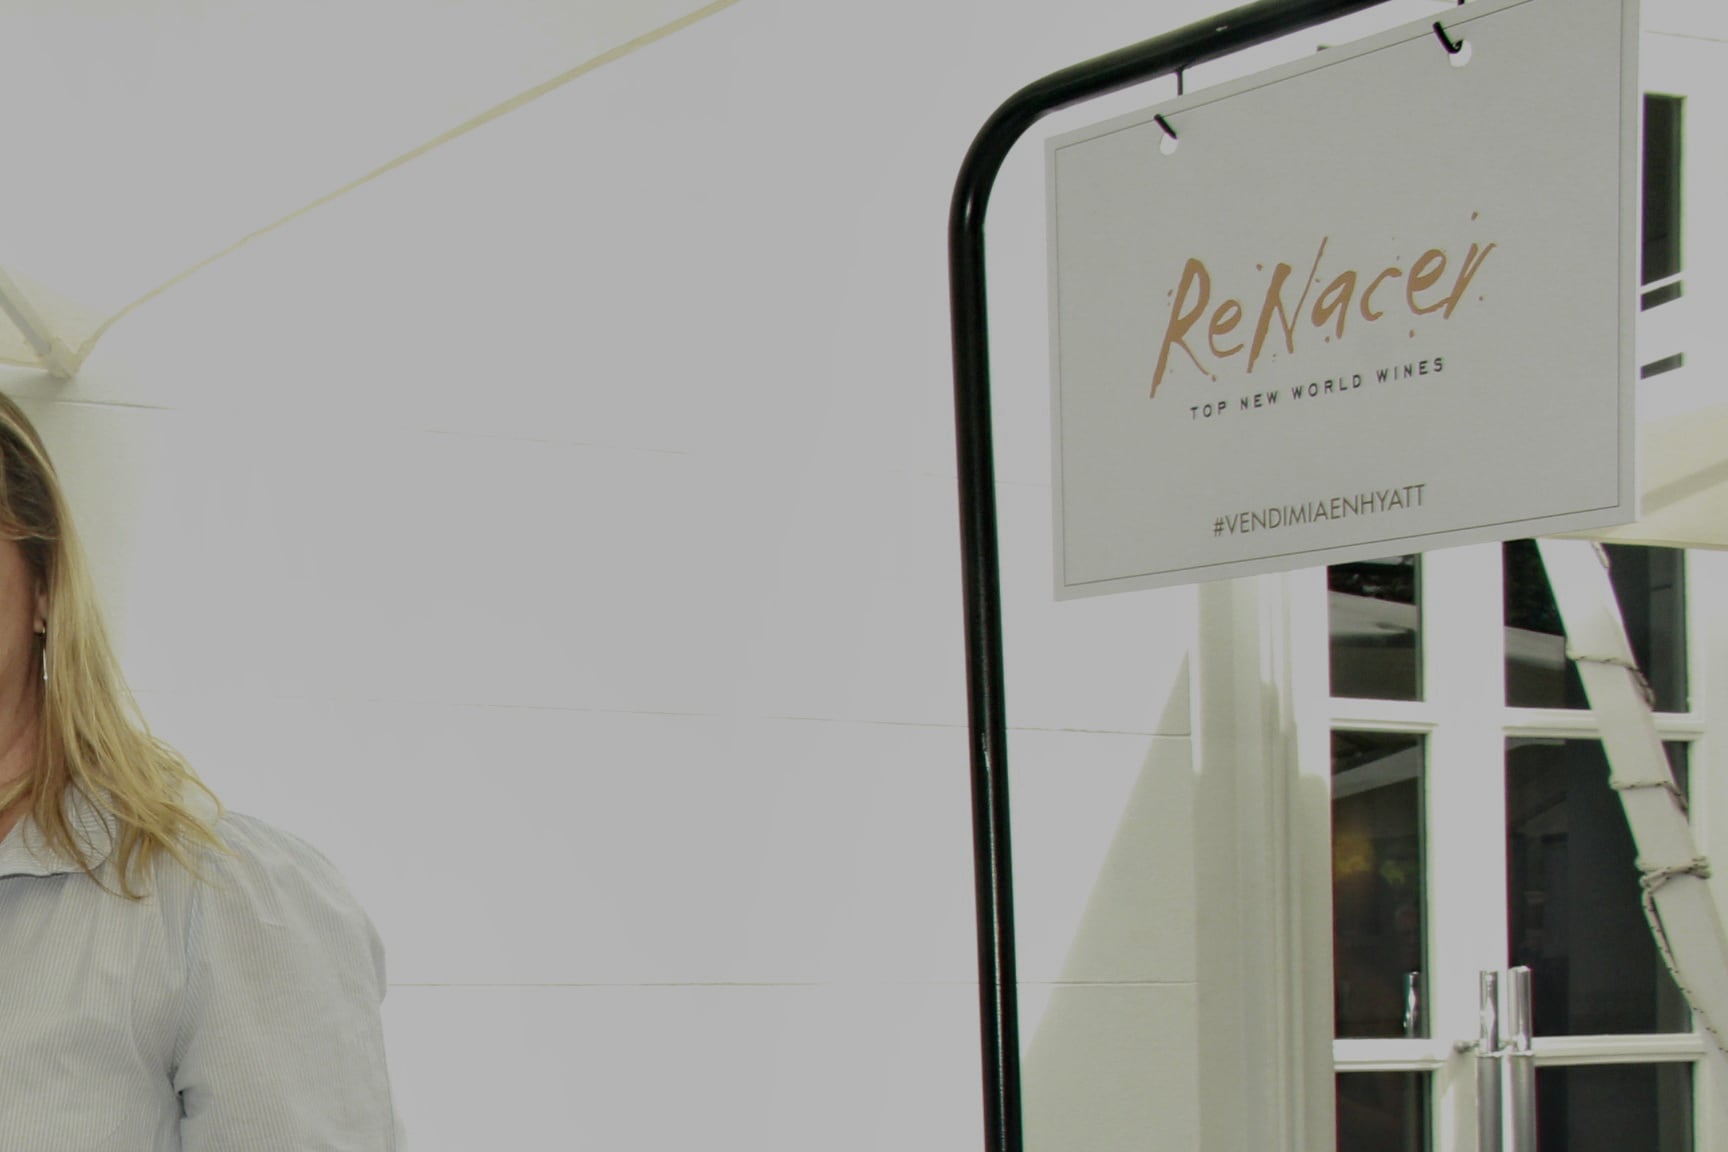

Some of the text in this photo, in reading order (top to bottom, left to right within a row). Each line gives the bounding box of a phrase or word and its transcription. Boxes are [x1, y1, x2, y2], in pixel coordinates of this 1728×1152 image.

[1150, 234, 1497, 398] ReNacer
[1190, 357, 1444, 420] TOP NEW WORLD WINES
[1213, 483, 1426, 537] #VENDIMIAENHYATT
